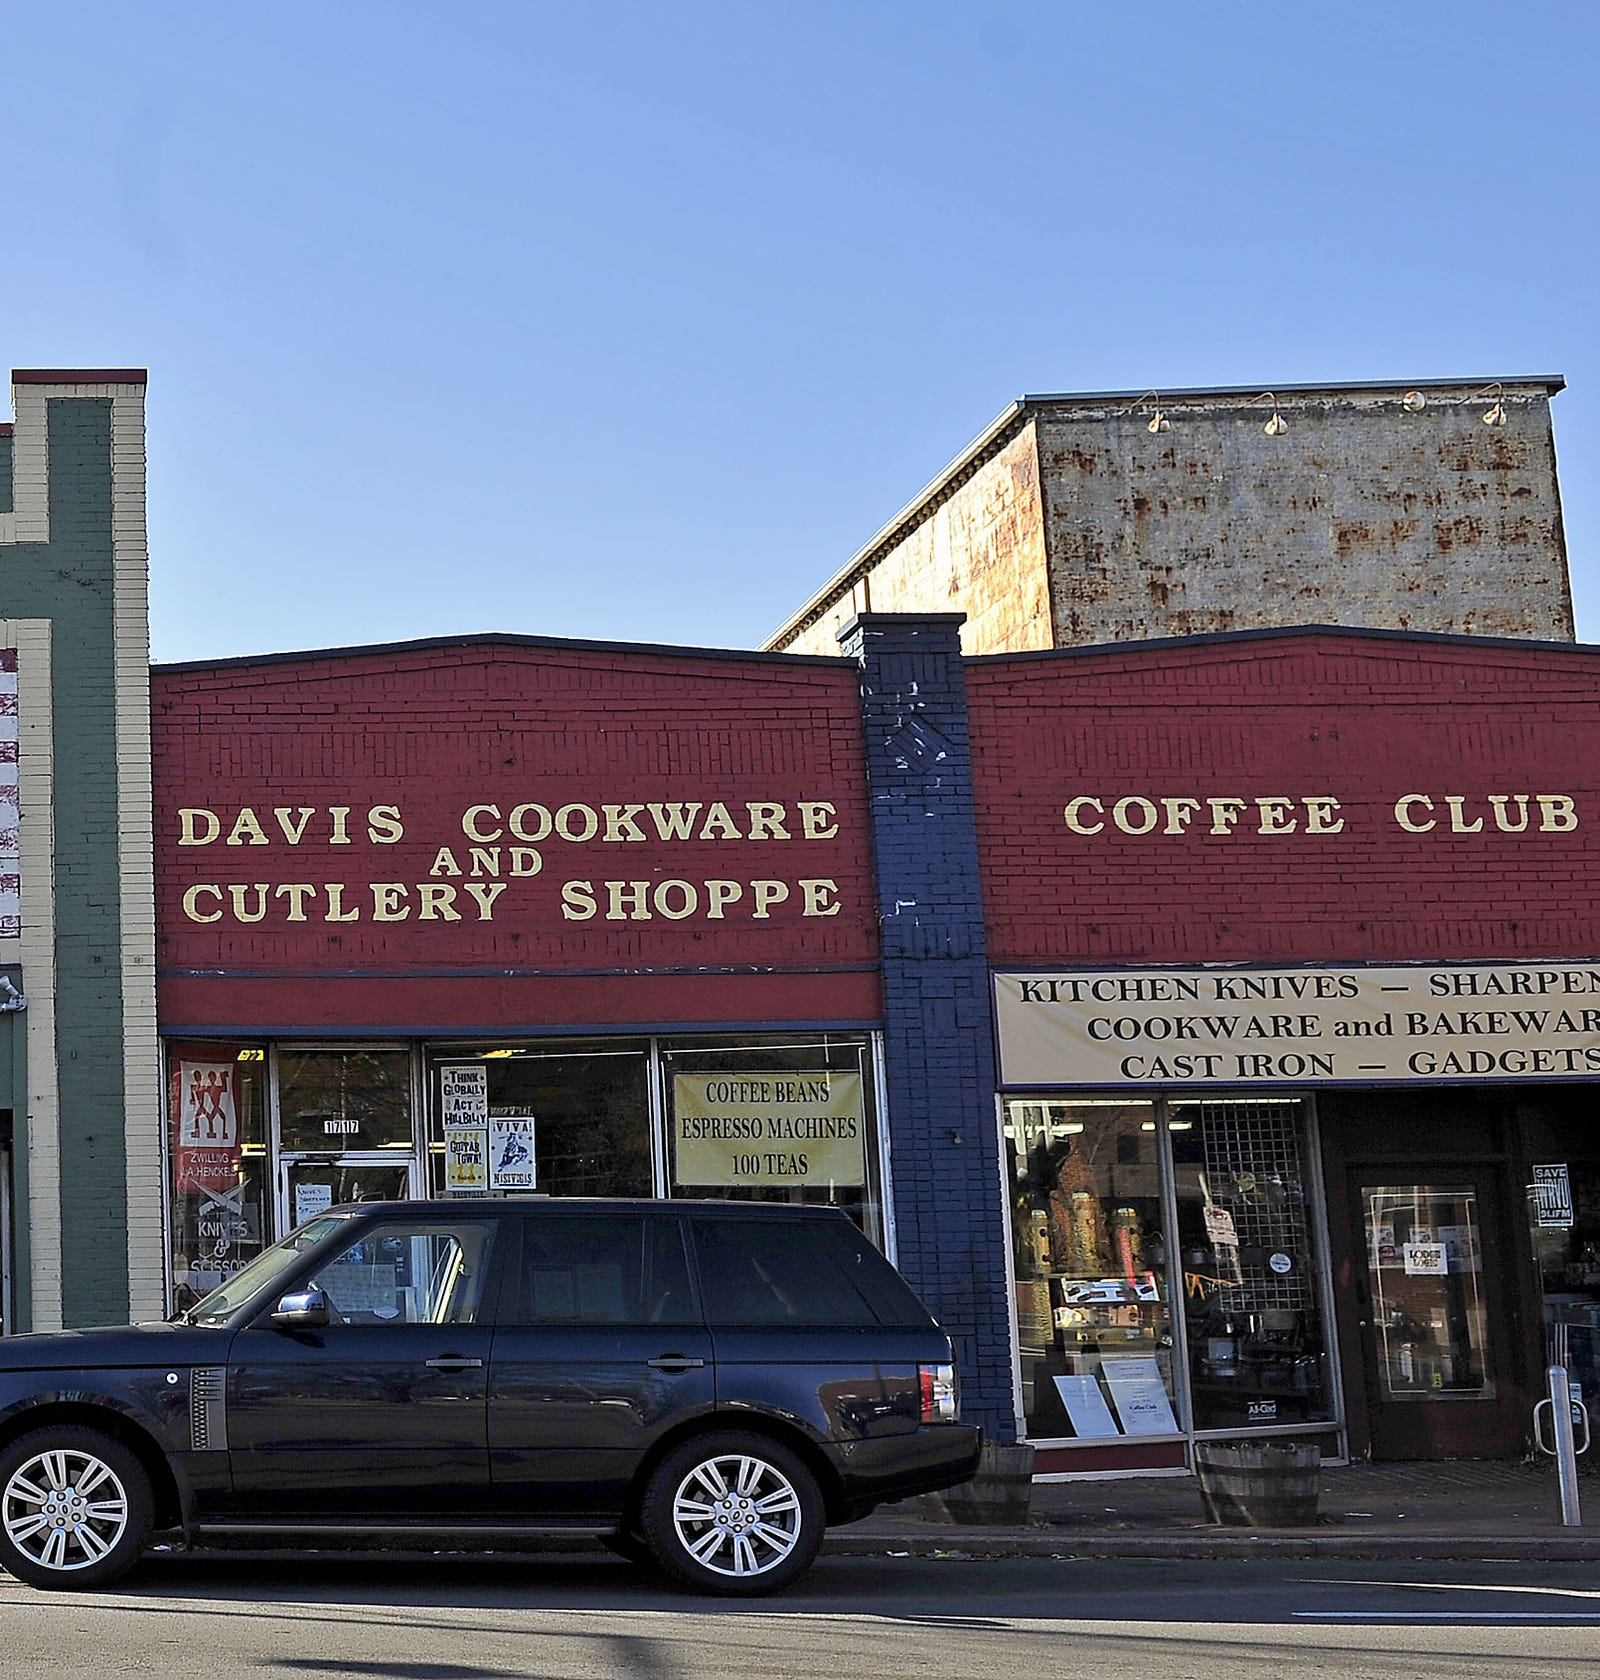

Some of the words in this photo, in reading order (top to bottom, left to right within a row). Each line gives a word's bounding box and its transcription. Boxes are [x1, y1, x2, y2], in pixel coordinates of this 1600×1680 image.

[177, 806, 405, 847] DAVIS
[462, 801, 841, 843] COOKWARE
[1064, 795, 1345, 835] COFFEE
[1394, 793, 1580, 833] CLUB
[429, 847, 544, 878] AND
[181, 882, 508, 923] CUTLERY
[560, 879, 843, 922] SHOPPE
[1018, 977, 1200, 1003] KITCHEN
[1212, 974, 1360, 1001] KNIVES
[1087, 1014, 1322, 1041] COOKWARE
[1333, 1013, 1394, 1037] and
[1404, 1008, 1600, 1036] BAKEWAR
[1120, 1054, 1223, 1079] CAST
[1234, 1052, 1335, 1078] IRON
[1407, 1047, 1600, 1076] GADGETS
[706, 1081, 771, 1103] COFFEE
[775, 1081, 830, 1102] BEANS
[453, 1099, 473, 1110] ACT
[325, 1121, 359, 1133] 1717
[682, 1117, 763, 1139] ESPRESSO
[767, 1116, 857, 1139] MACHINES
[190, 1153, 229, 1163] ZWILLING
[732, 1155, 760, 1175] 100
[764, 1153, 809, 1175] TEAS
[1536, 1168, 1566, 1178] SAVE
[213, 1239, 231, 1258] &
[1409, 1250, 1441, 1259] LODGE
